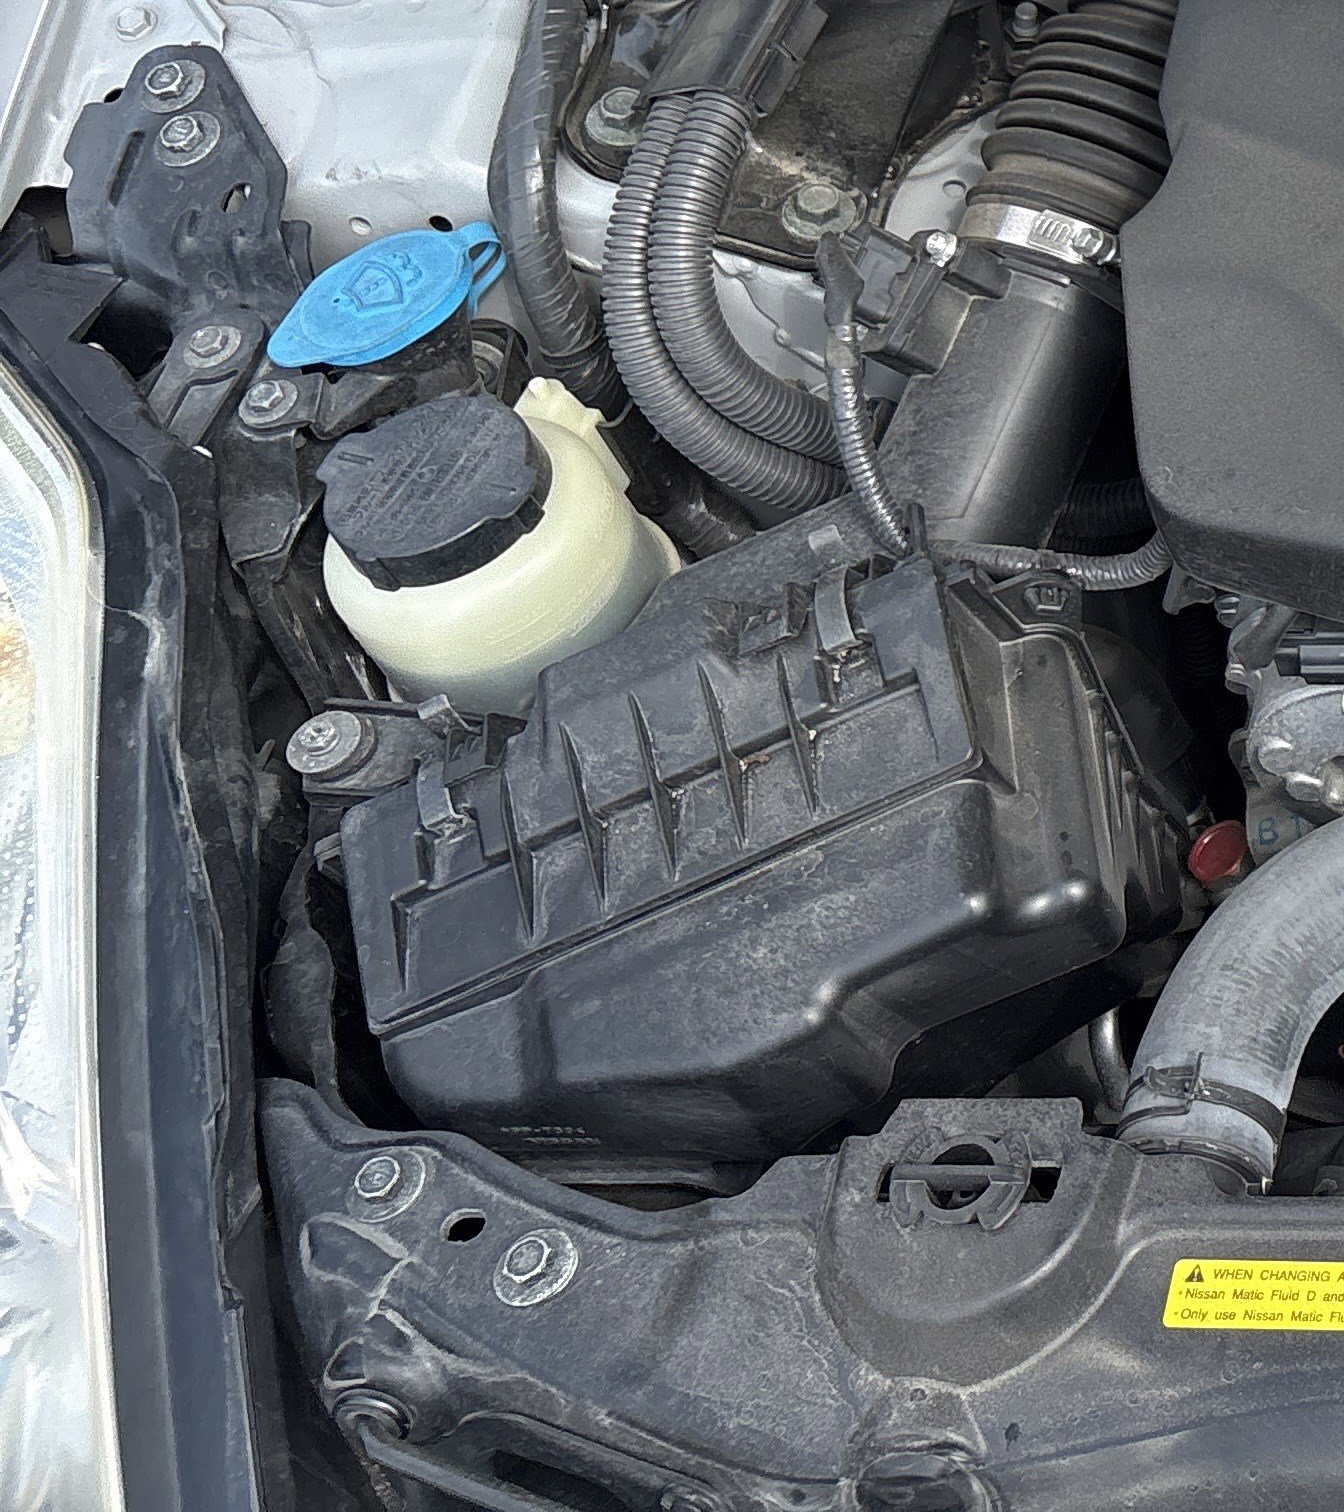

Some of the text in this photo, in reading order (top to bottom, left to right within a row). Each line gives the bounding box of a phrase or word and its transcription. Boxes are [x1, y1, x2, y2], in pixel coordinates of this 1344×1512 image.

[1213, 1269, 1254, 1280] WHEN
[1259, 1270, 1331, 1282] CHANGING
[1184, 1288, 1226, 1300] Nissan
[1232, 1289, 1265, 1300] Matic
[1270, 1290, 1300, 1301] Fluid
[1306, 1291, 1317, 1302] D
[1180, 1308, 1209, 1321] Only
[1214, 1310, 1237, 1321] use
[1243, 1310, 1284, 1321] Nissan
[1290, 1311, 1324, 1323] Matic
